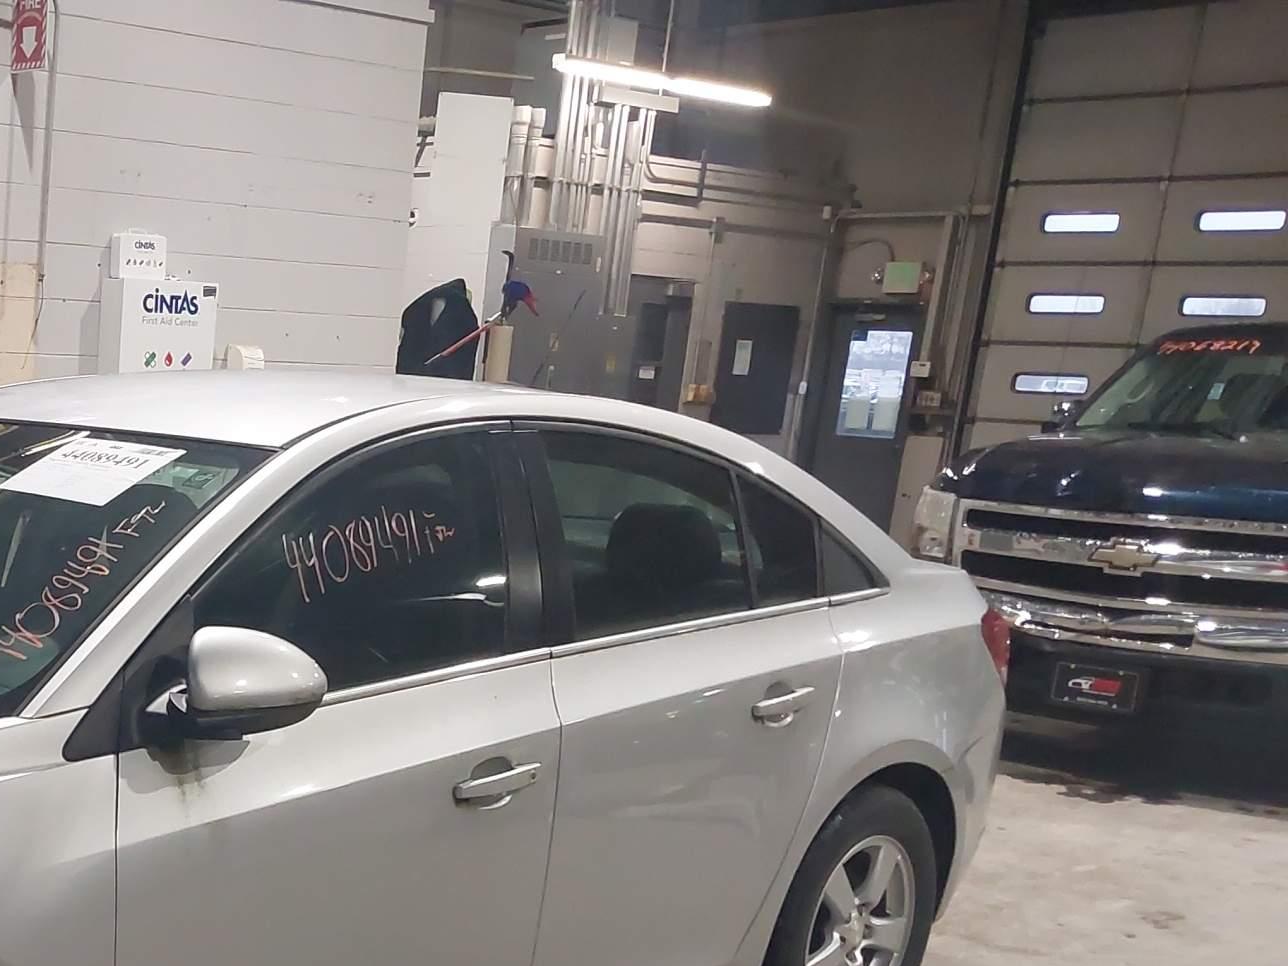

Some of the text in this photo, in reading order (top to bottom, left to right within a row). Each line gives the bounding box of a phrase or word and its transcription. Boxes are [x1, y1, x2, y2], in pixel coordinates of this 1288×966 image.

[134, 240, 156, 250] CINTAS
[142, 287, 199, 315] CINTAS
[142, 316, 198, 327] First Aid Center
[61, 450, 150, 469] 44089491
[281, 505, 421, 603] 44089491
